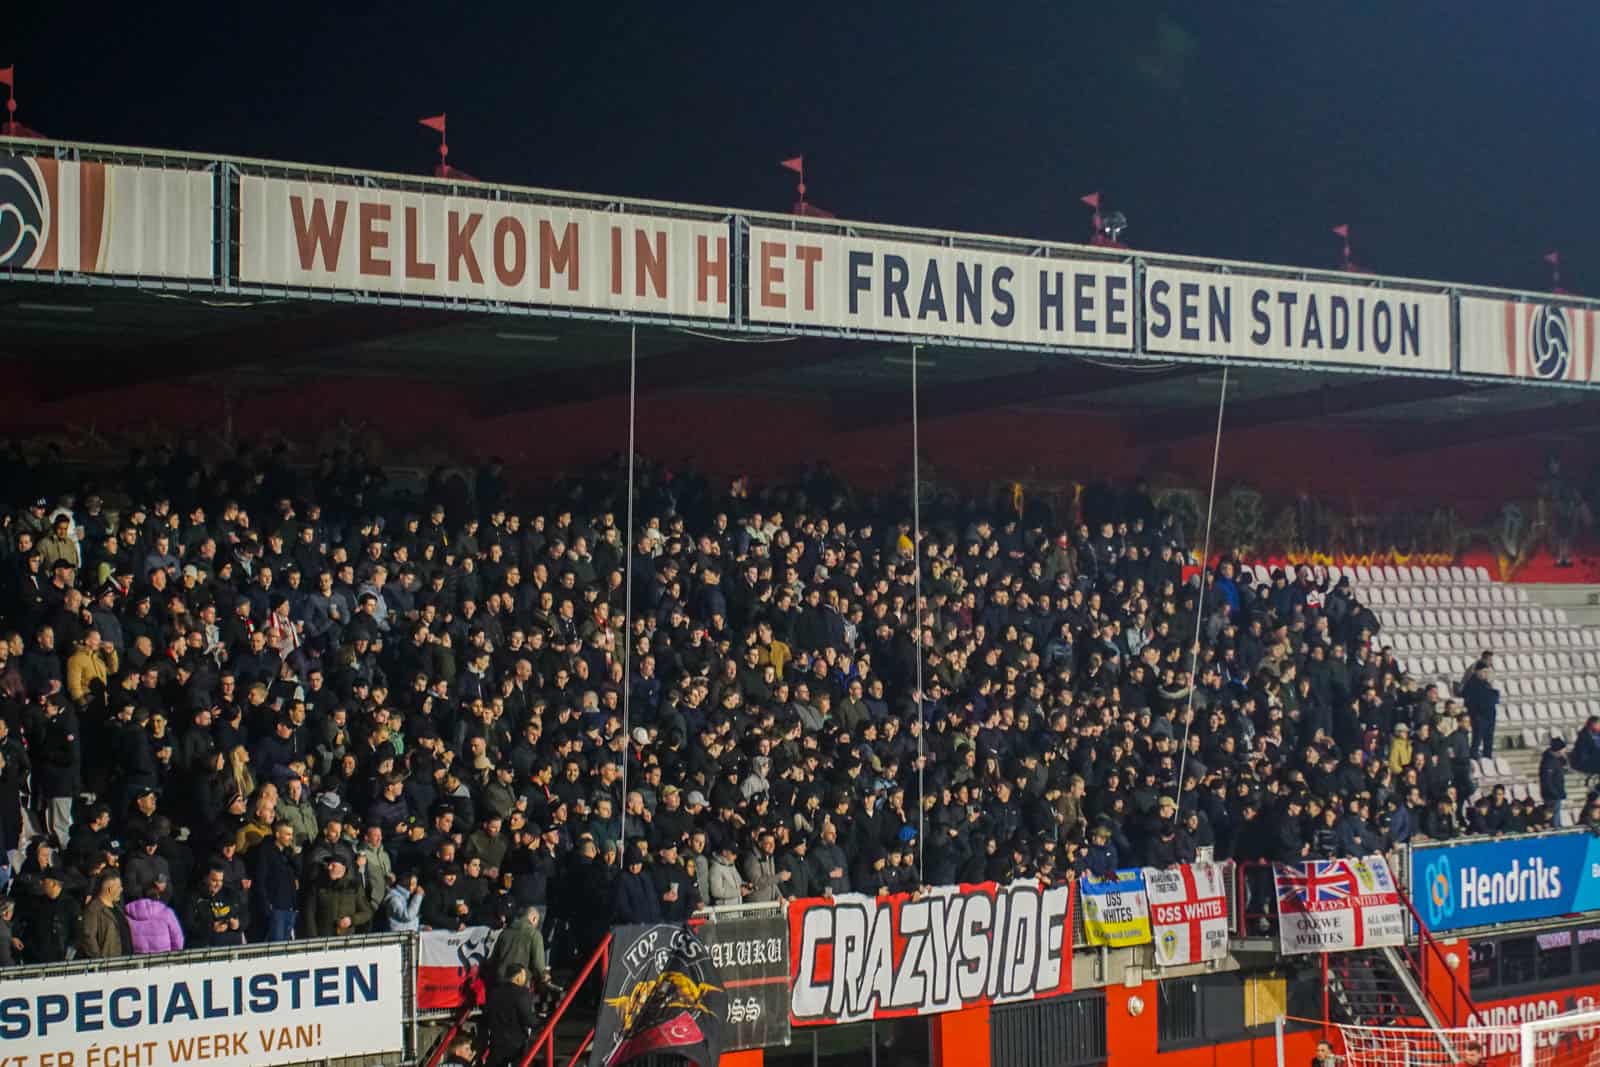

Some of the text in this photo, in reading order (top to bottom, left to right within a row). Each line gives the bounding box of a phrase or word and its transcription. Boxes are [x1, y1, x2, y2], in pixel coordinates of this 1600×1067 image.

[290, 195, 1422, 357] WELKOM IN HET FRANS HEESEN STADION
[1105, 890, 1122, 906] OSS
[1460, 856, 1561, 909] Hendriks
[1102, 907, 1133, 924] WHITES
[1157, 905, 1181, 923] OSS
[1296, 918, 1341, 930] CREWE
[626, 931, 658, 968] TOP
[791, 885, 1069, 1021] CRAZYSIDE
[1296, 932, 1343, 945] WHITES
[0, 963, 379, 1040] SPECIALISTEN
[87, 1041, 158, 1067] ÉCHT
[168, 1032, 249, 1063] WERK
[259, 1024, 322, 1053] VAN!
